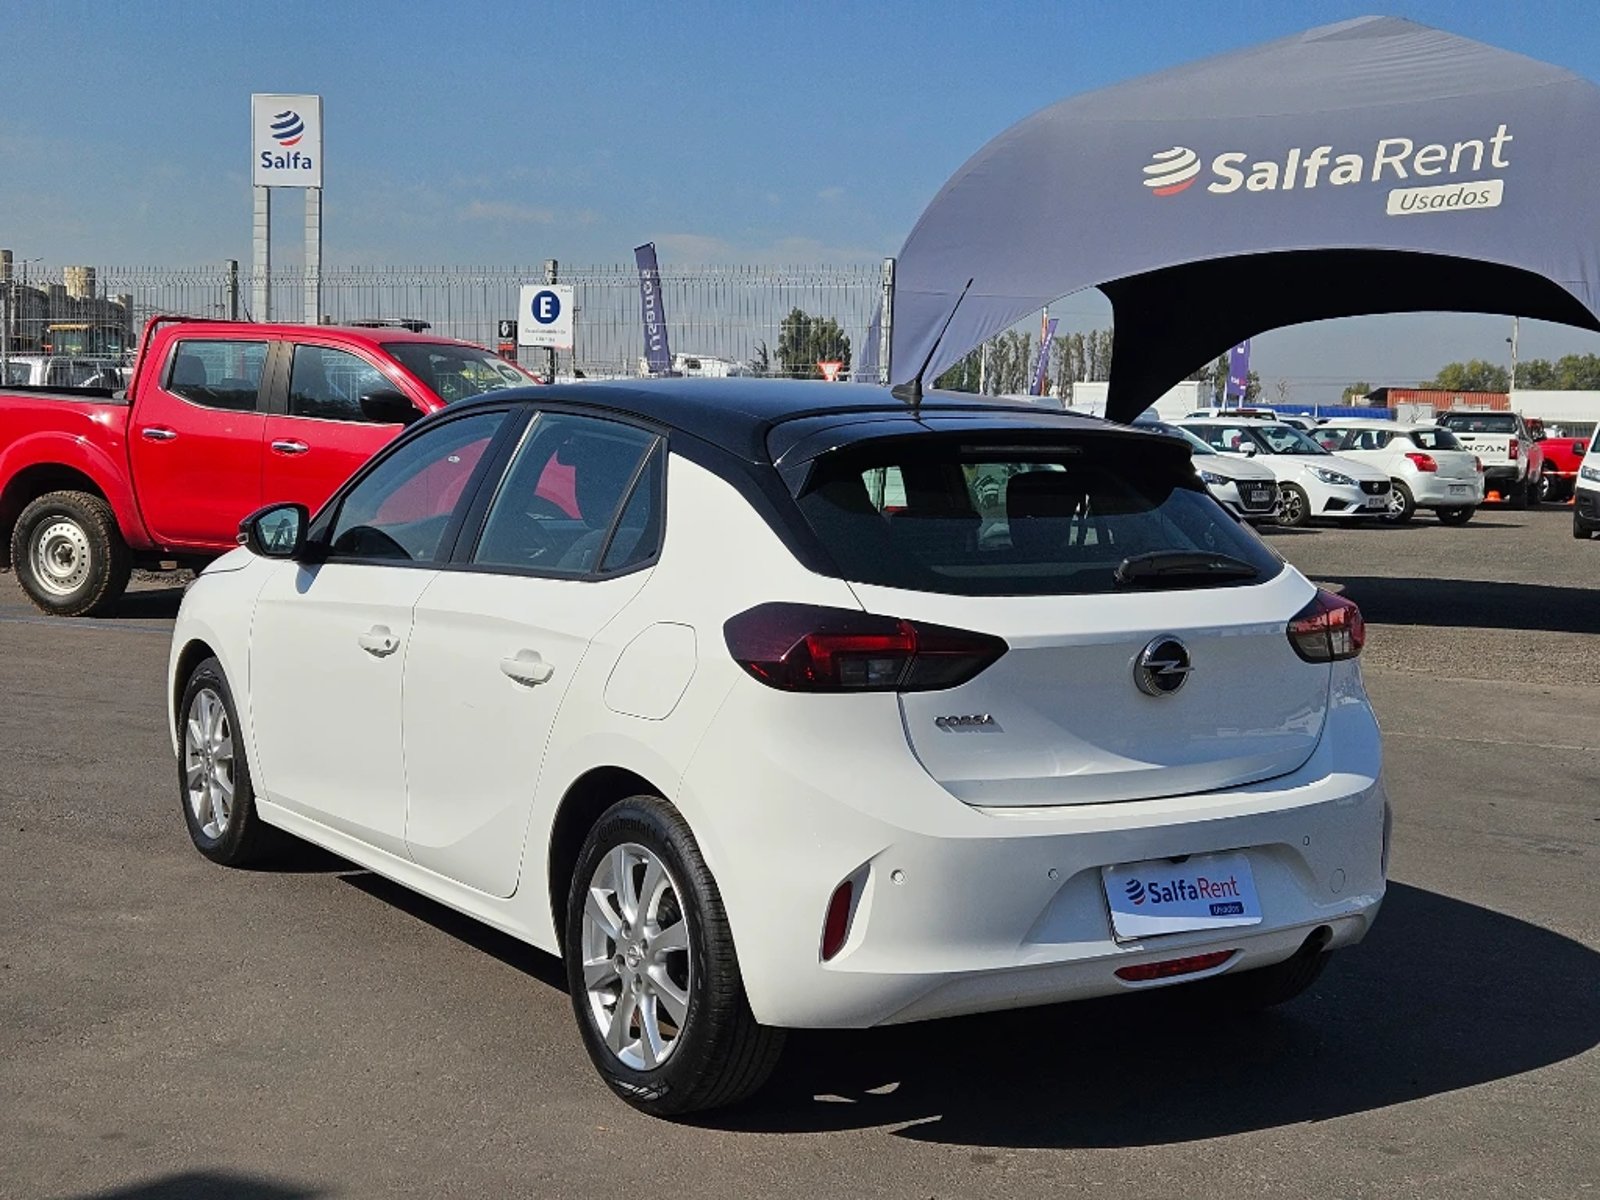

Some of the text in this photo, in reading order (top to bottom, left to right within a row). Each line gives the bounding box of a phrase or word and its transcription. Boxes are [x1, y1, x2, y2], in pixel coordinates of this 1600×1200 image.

[260, 151, 312, 170] Salfa
[1207, 124, 1513, 194] SalfaRent
[1399, 186, 1490, 211] Usados
[540, 296, 553, 318] E
[1463, 444, 1506, 452] NGAN
[933, 713, 995, 727] CORSA
[1147, 876, 1240, 904] SalfaRent
